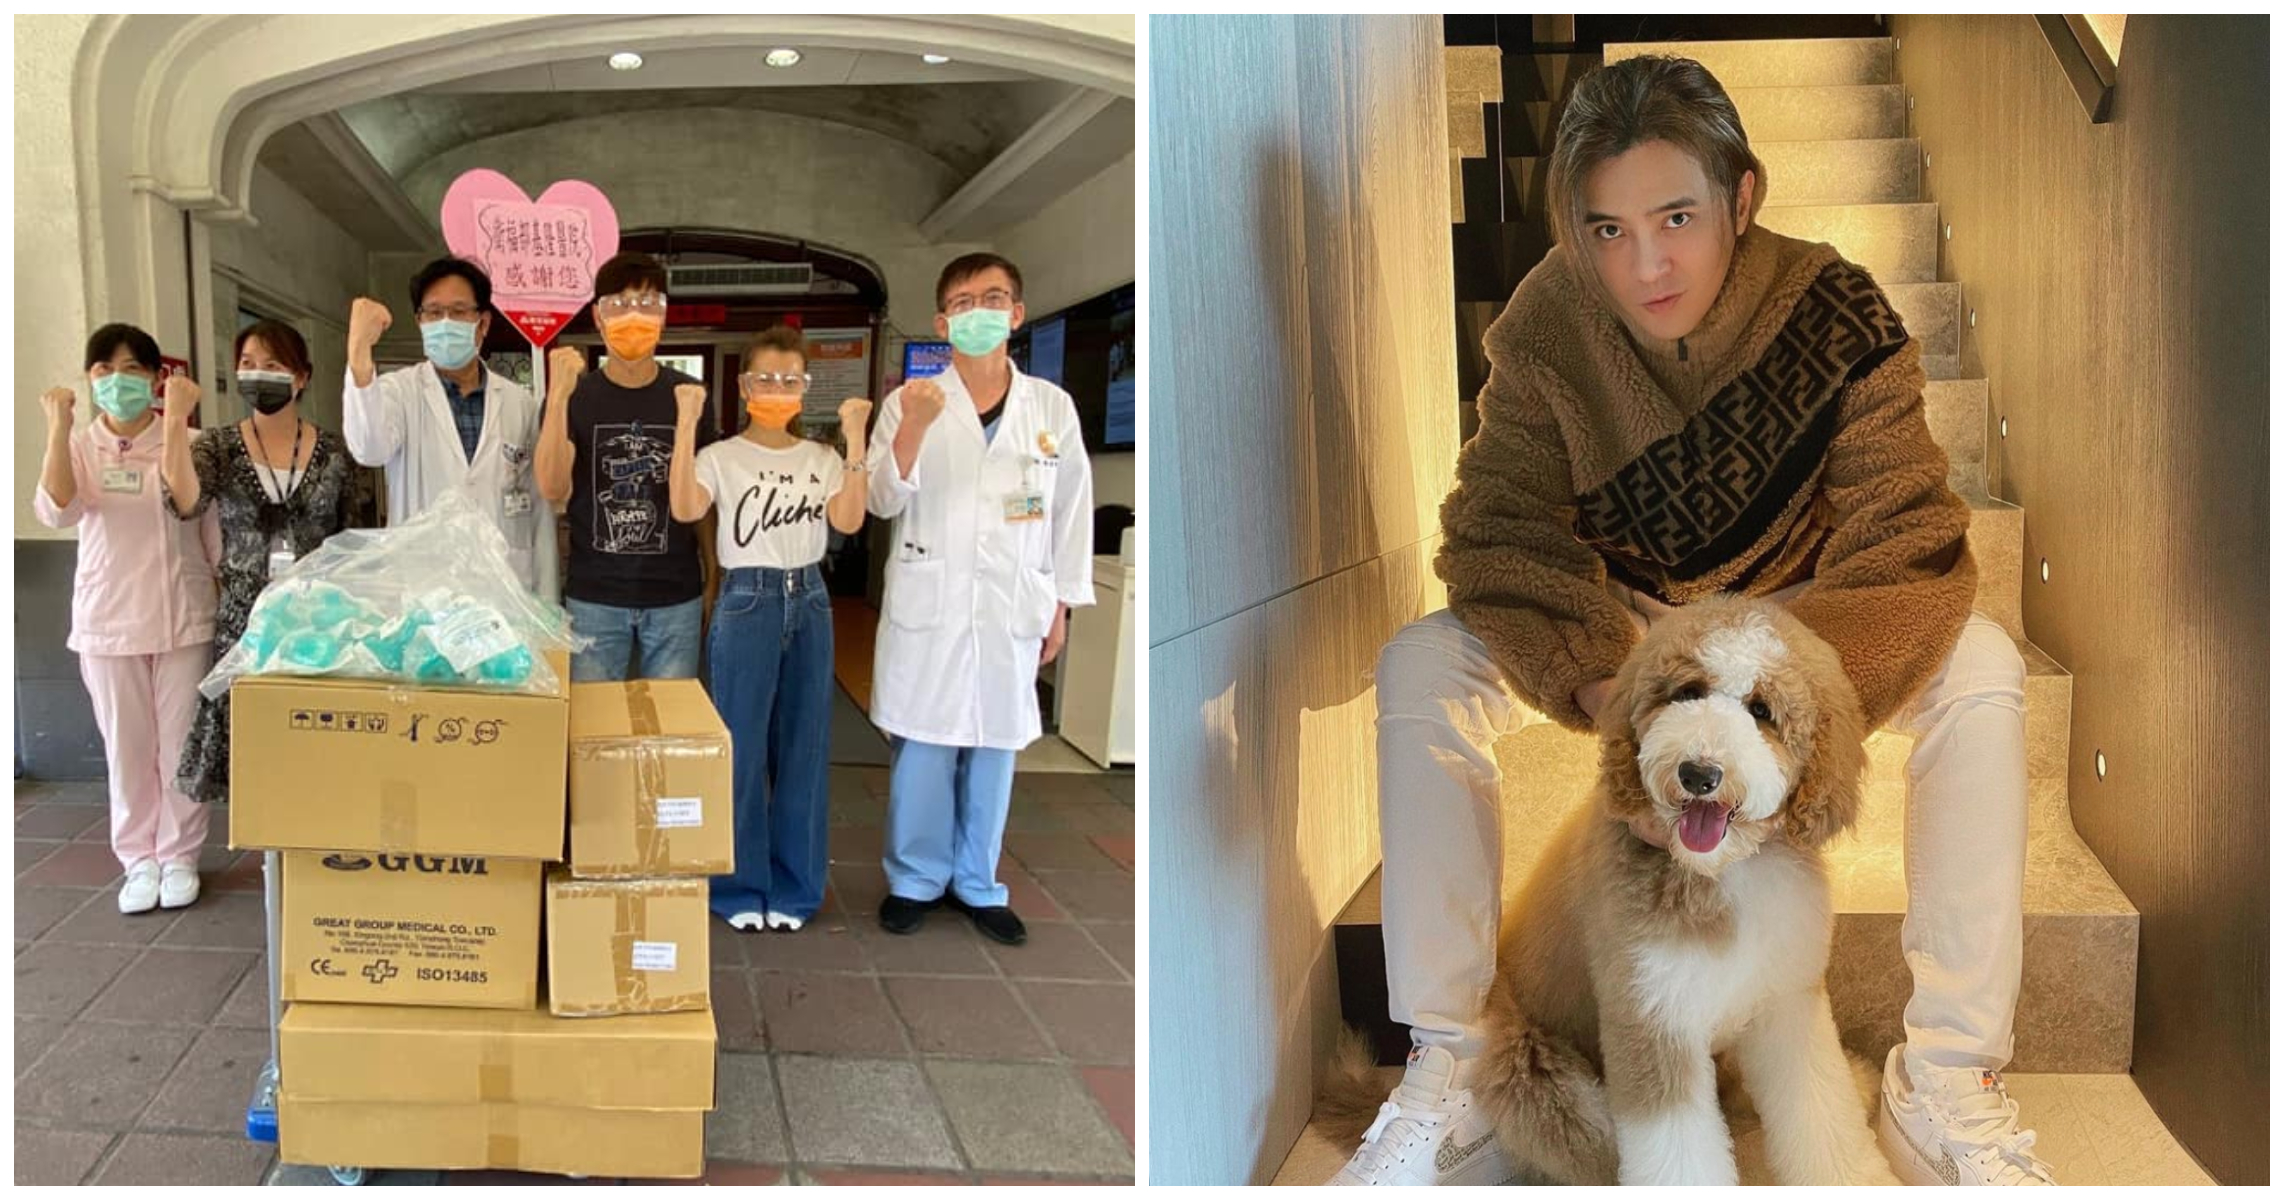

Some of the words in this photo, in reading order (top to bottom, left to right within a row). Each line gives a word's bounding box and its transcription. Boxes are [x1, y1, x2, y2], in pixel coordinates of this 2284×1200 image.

[505, 263, 579, 289] 感謝您
[810, 473, 820, 484] A
[378, 853, 488, 875] GGM
[313, 917, 351, 928] GREAT
[354, 919, 394, 930] GROUP
[397, 921, 446, 933] MEDICAL
[417, 968, 488, 983] ISO13485
